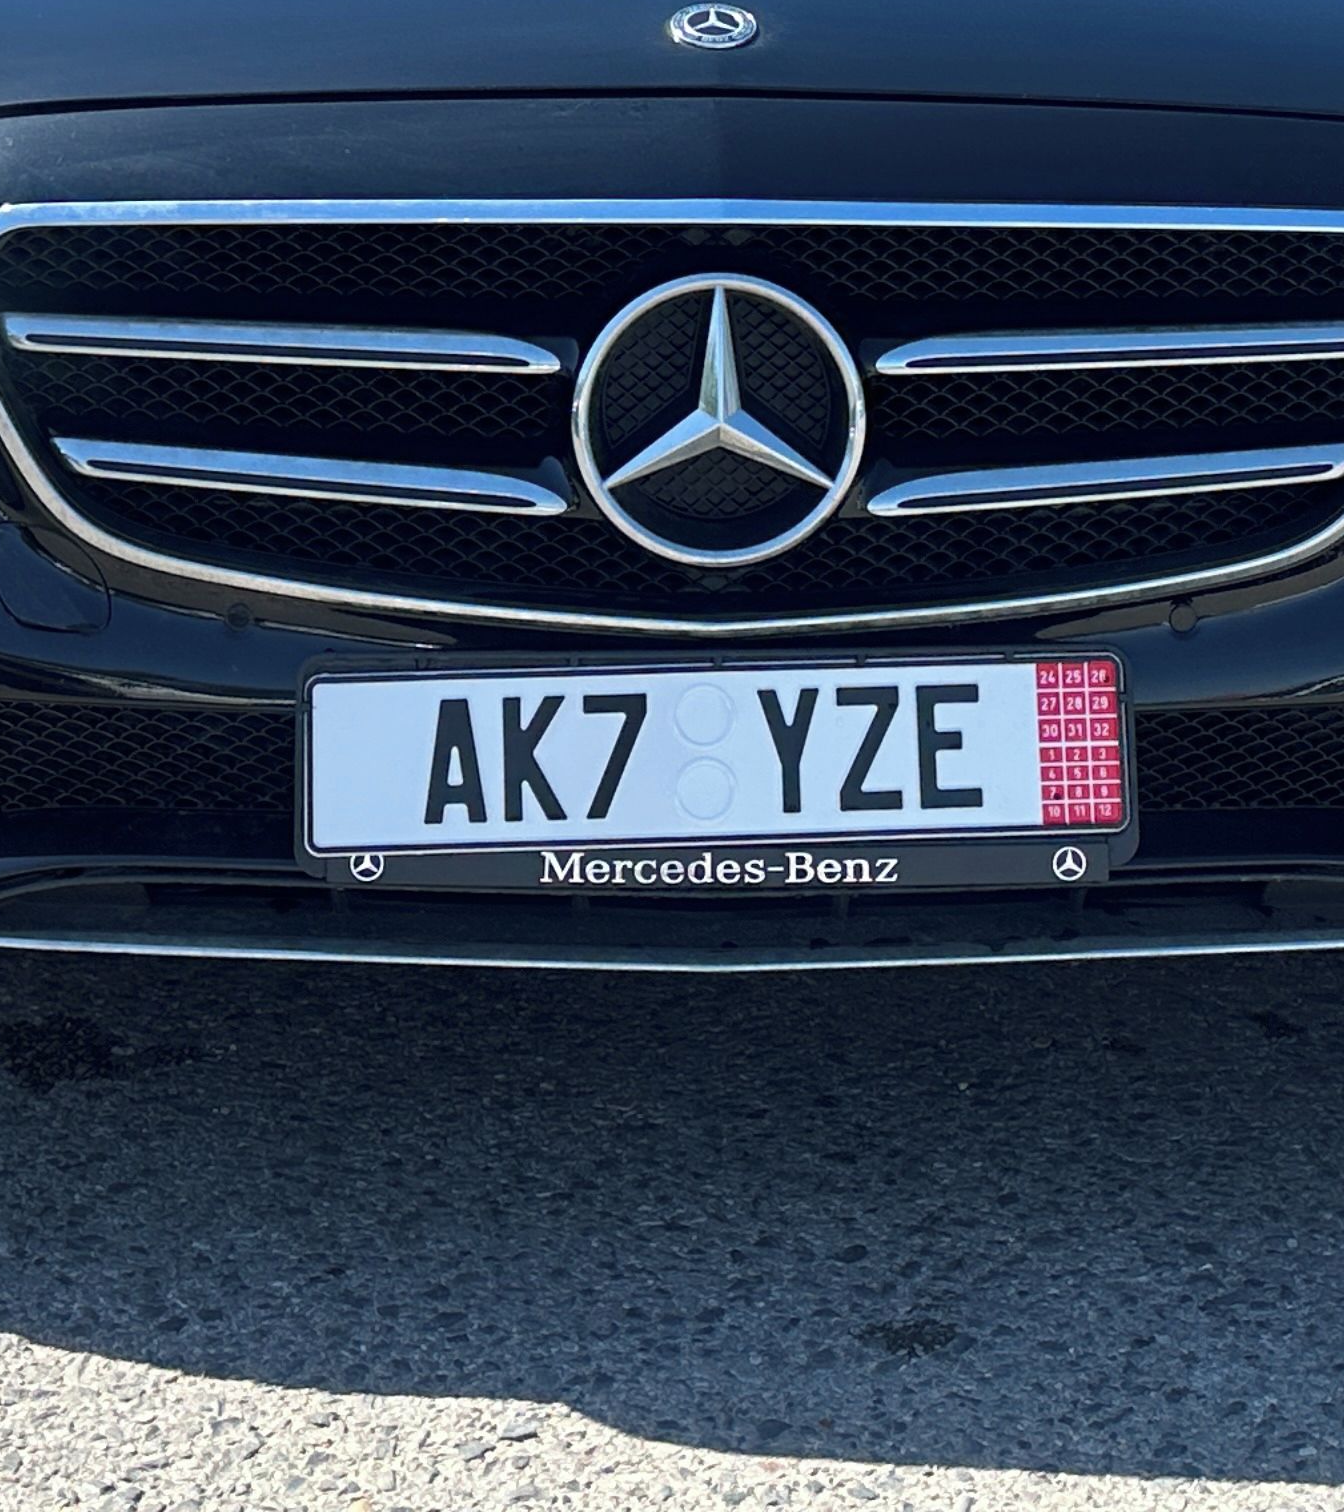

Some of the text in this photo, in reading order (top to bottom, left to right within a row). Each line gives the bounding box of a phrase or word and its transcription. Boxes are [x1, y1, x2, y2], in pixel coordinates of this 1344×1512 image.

[1040, 671, 1056, 685] 24
[1065, 670, 1082, 684] 25
[1041, 696, 1109, 711] 27 28 29
[1042, 723, 1110, 738] 30 31 32
[424, 684, 984, 825] AK7 YZE
[1049, 748, 1106, 761] 1 2 3
[1048, 768, 1056, 779] 4
[1048, 804, 1112, 817] 10 11 12
[540, 851, 898, 884] Mercedes-Benz
